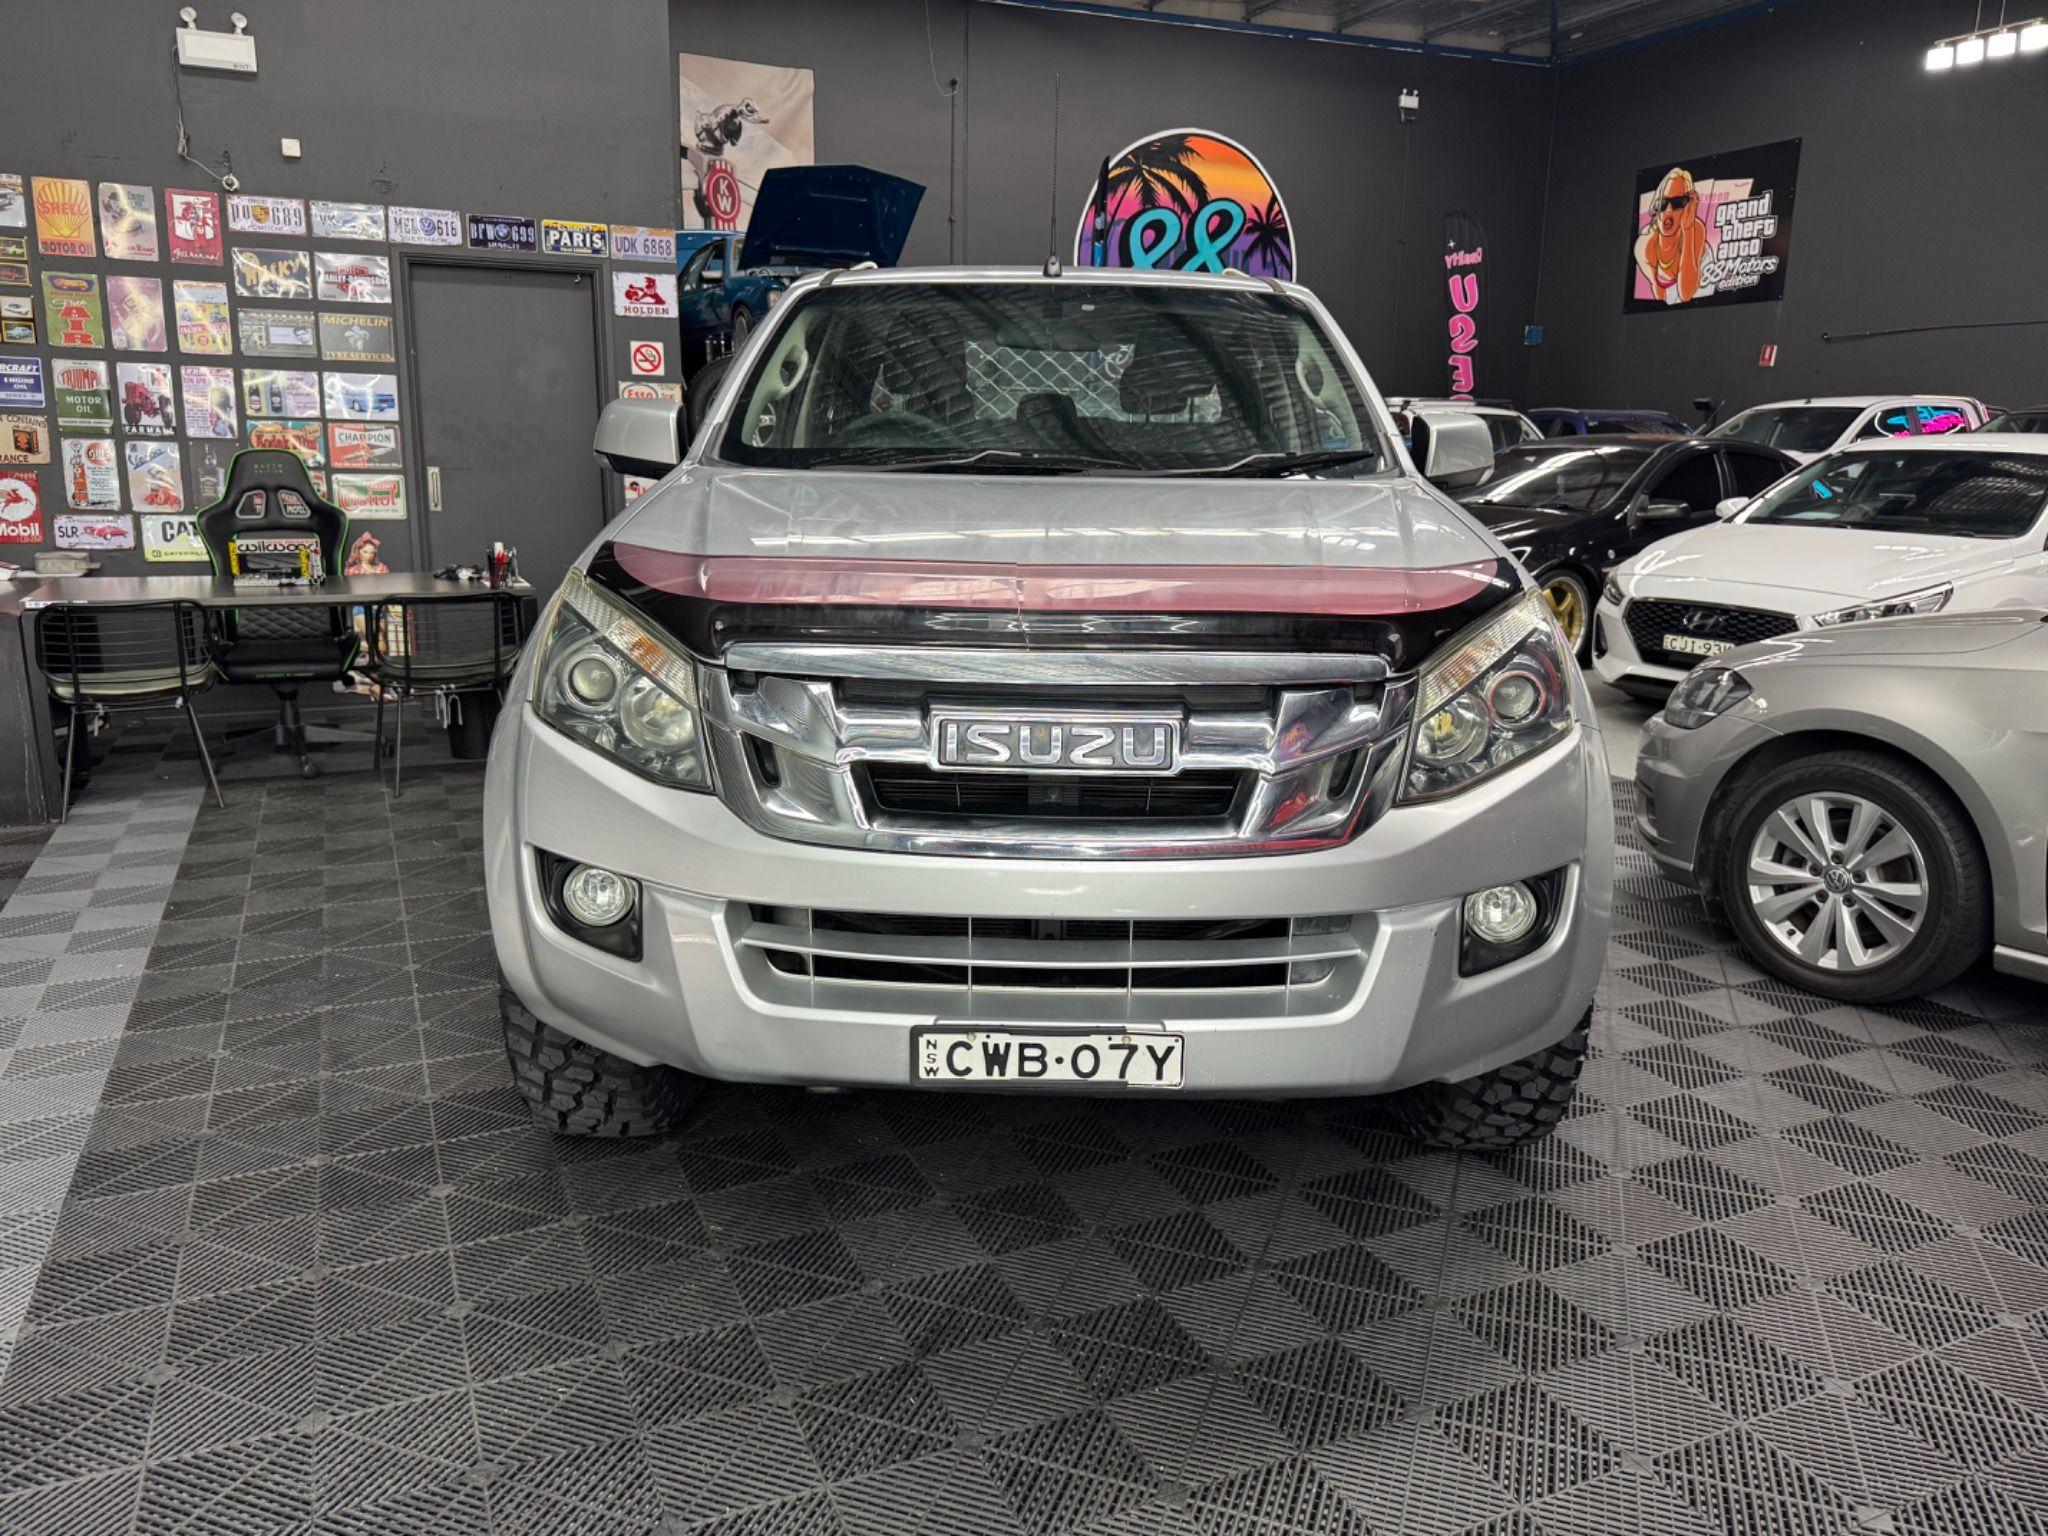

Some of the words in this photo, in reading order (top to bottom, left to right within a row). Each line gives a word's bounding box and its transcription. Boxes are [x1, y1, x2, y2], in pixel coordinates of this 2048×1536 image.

[41, 202, 85, 216] SHELL
[271, 206, 302, 227] 689
[511, 225, 535, 243] 699
[1722, 217, 1775, 241] theft
[549, 230, 603, 249] PARIS
[614, 236, 639, 253] UDK
[643, 238, 672, 256] 6868
[1718, 239, 1760, 260] auto
[623, 306, 670, 315] HOLDEN
[323, 316, 388, 327] MICHELIN
[65, 396, 102, 405] MOTOR
[76, 404, 93, 413] OIL
[7, 414, 47, 428] CONTAINS
[58, 526, 79, 538] SLR
[237, 541, 318, 552] wilwood
[946, 723, 1166, 766] ISUZU
